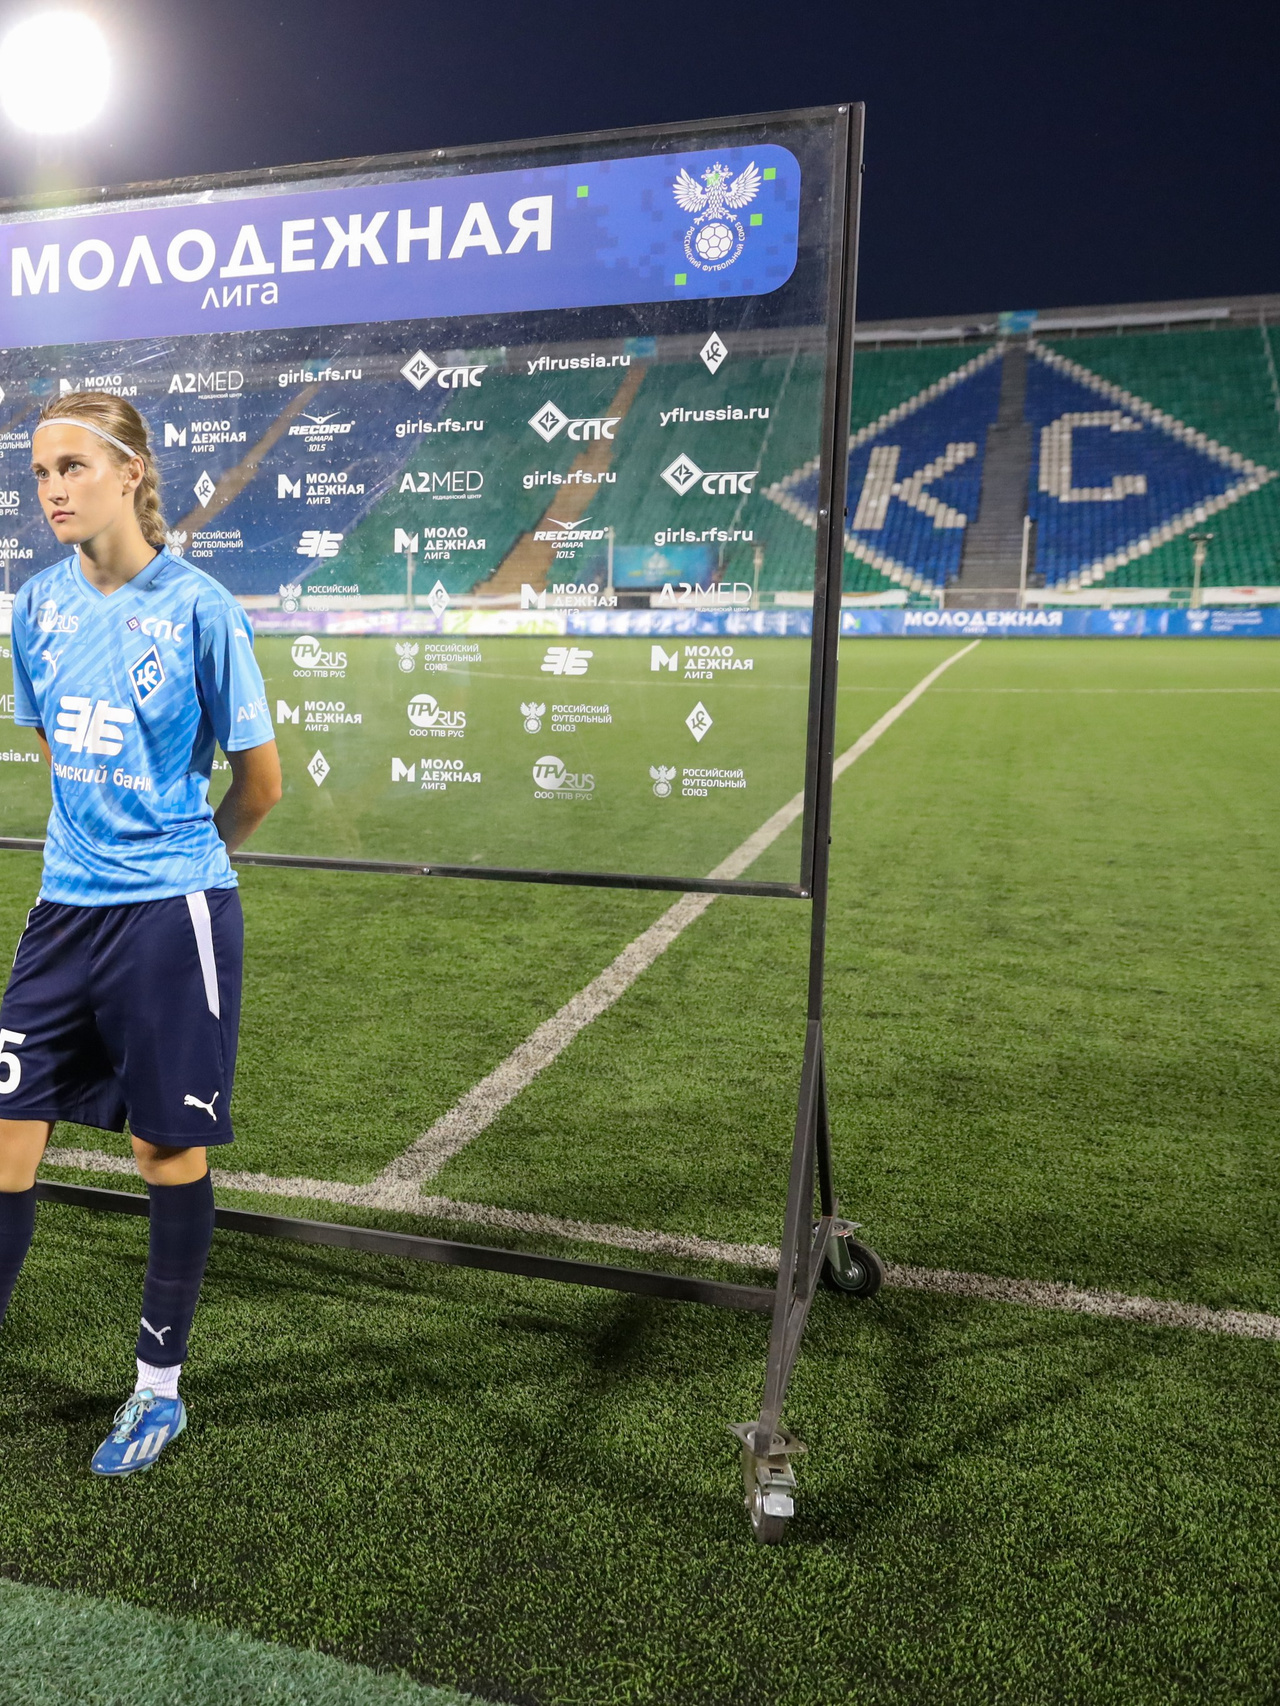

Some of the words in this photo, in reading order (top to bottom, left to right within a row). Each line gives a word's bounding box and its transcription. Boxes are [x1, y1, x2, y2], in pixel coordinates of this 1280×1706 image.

[12, 195, 553, 297] МОЛОДЕЖНАЯ
[684, 226, 702, 268] РОССИЙСКИЙ
[702, 243, 744, 272] ФУТБОЛЬНЫЙ
[735, 222, 745, 241] СОЮЗ
[201, 280, 278, 311] лига
[528, 354, 630, 375] yflrussia.ru
[85, 376, 122, 387] МОЛО
[168, 371, 244, 393] A2MED
[278, 368, 361, 387] girls.rfs.ru
[660, 405, 769, 426] yflrussia.ru
[192, 421, 230, 432] МОЛО
[288, 424, 352, 435] RECORD
[395, 419, 483, 438] girls.rfs.ru
[192, 432, 246, 444] ДЕЖНАЯ
[192, 445, 214, 453] лига
[306, 473, 347, 484] МОЛО
[399, 471, 483, 493] A2MED
[523, 470, 616, 489] girls.rfs.ru
[306, 484, 364, 496] ДЕЖНАЯ
[306, 497, 330, 505] лига
[192, 530, 240, 539] РОССИЙСКИЙ
[424, 527, 468, 538] МОЛО
[533, 530, 605, 540] RECORD
[654, 528, 753, 546] girls.rfs.ru
[192, 539, 243, 549] ФУТБОЛЬНЫЙ
[424, 539, 485, 550] ДЕЖНАЯ
[424, 551, 450, 559] лига
[308, 584, 359, 593] РОССИЙСКИЙ
[552, 583, 599, 594] МОЛО
[659, 583, 752, 604] A2MED
[553, 596, 617, 607] ДЕЖНАЯ
[904, 611, 1063, 627] МОЛОДЕЖНАЯ
[425, 644, 479, 652] РОССИЙСКИЙ
[685, 646, 733, 657] МОЛО
[425, 654, 481, 662] ФУТБОЛЬНЫЙ
[425, 663, 447, 671] СОЮЗ
[684, 659, 753, 670] ДЕЖНАЯ
[684, 671, 713, 679] лига
[305, 701, 345, 711] МОЛО
[552, 704, 609, 714] РОССИЙСКИЙ
[305, 713, 362, 723] ДЕЖНАЯ
[552, 714, 612, 723] ФУТБОЛЬНЫЙ
[305, 724, 329, 732] лига
[430, 729, 446, 737] ТПВ
[551, 724, 576, 732] СОЮЗ
[421, 759, 463, 770] МОЛО
[54, 763, 107, 783] емский
[421, 771, 481, 783] ДЕЖНАЯ
[683, 768, 743, 778] РОССИЙСКИЙ
[682, 779, 746, 788] ФУТБОЛЬНЫЙ
[556, 792, 573, 800] ТПВ
[682, 789, 707, 797] СОЮЗ
